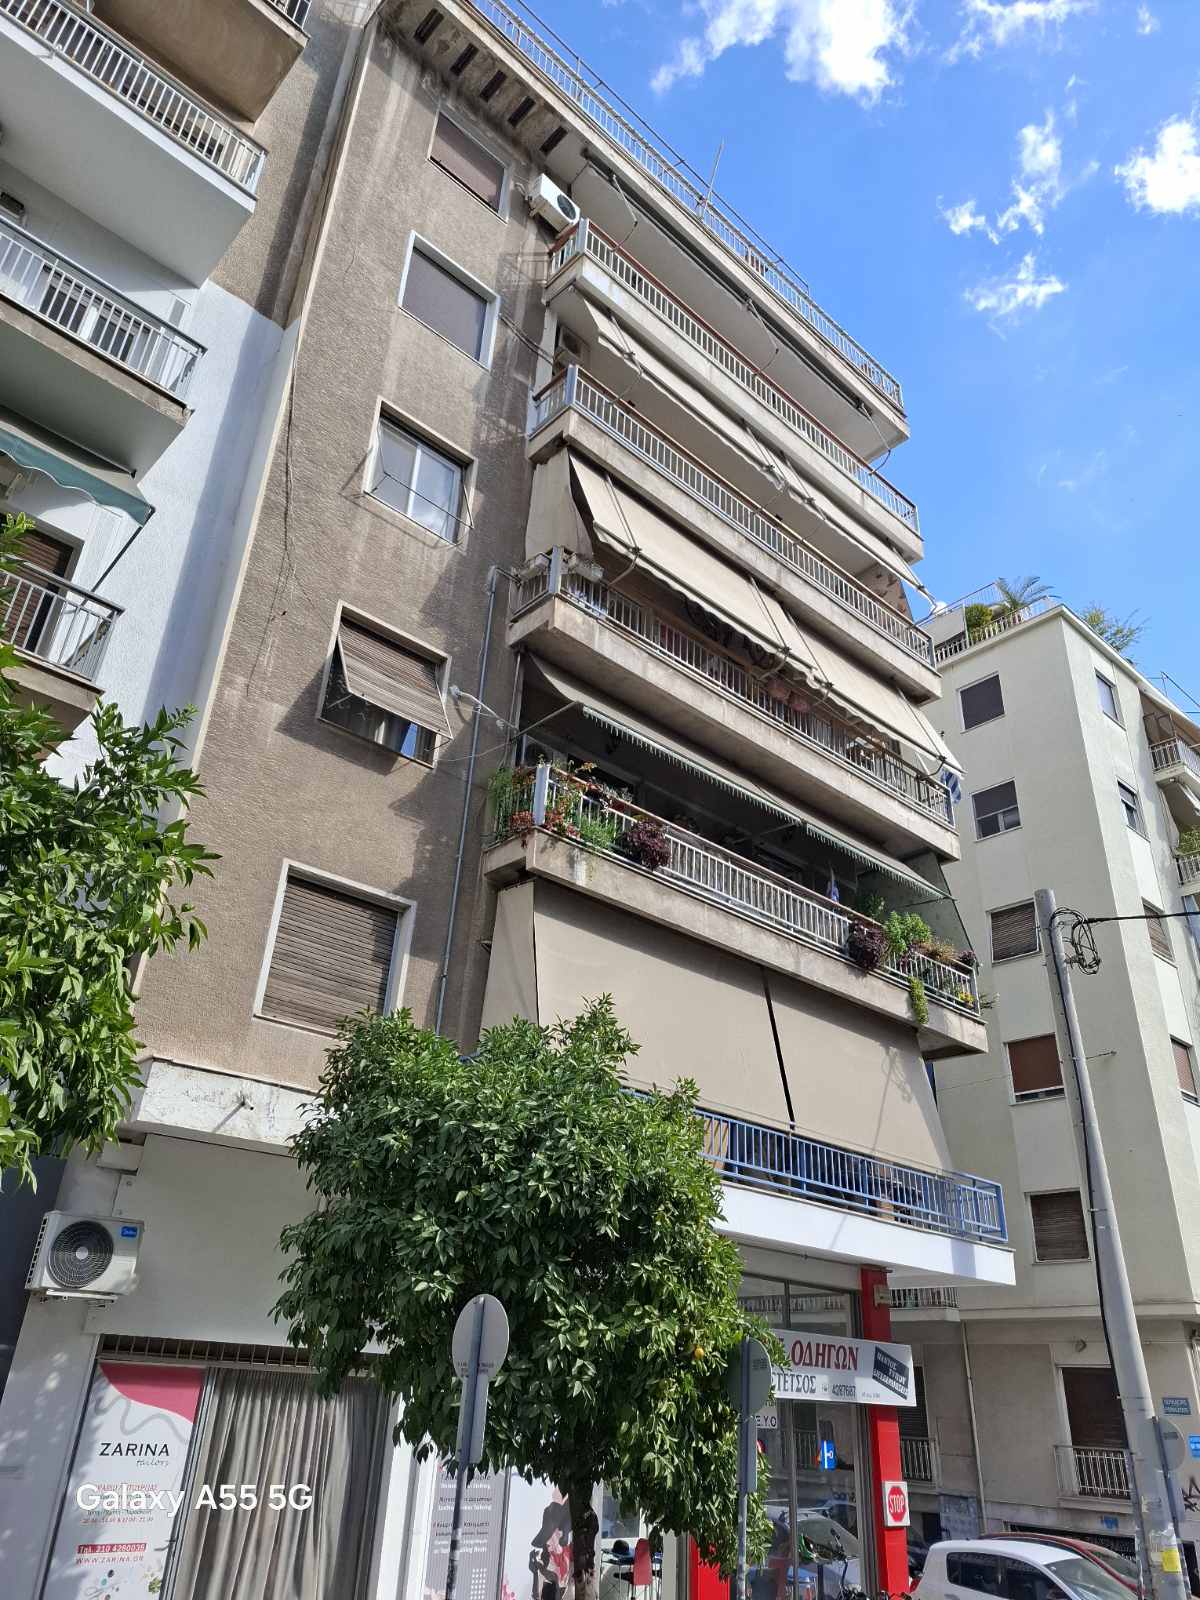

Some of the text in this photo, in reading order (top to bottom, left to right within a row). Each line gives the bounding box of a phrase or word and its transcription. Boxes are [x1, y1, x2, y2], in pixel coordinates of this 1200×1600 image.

[792, 1340, 859, 1371] ΟΔΗΓΩΝ
[99, 1442, 170, 1457] ZARINA
[889, 1494, 905, 1513] STOP
